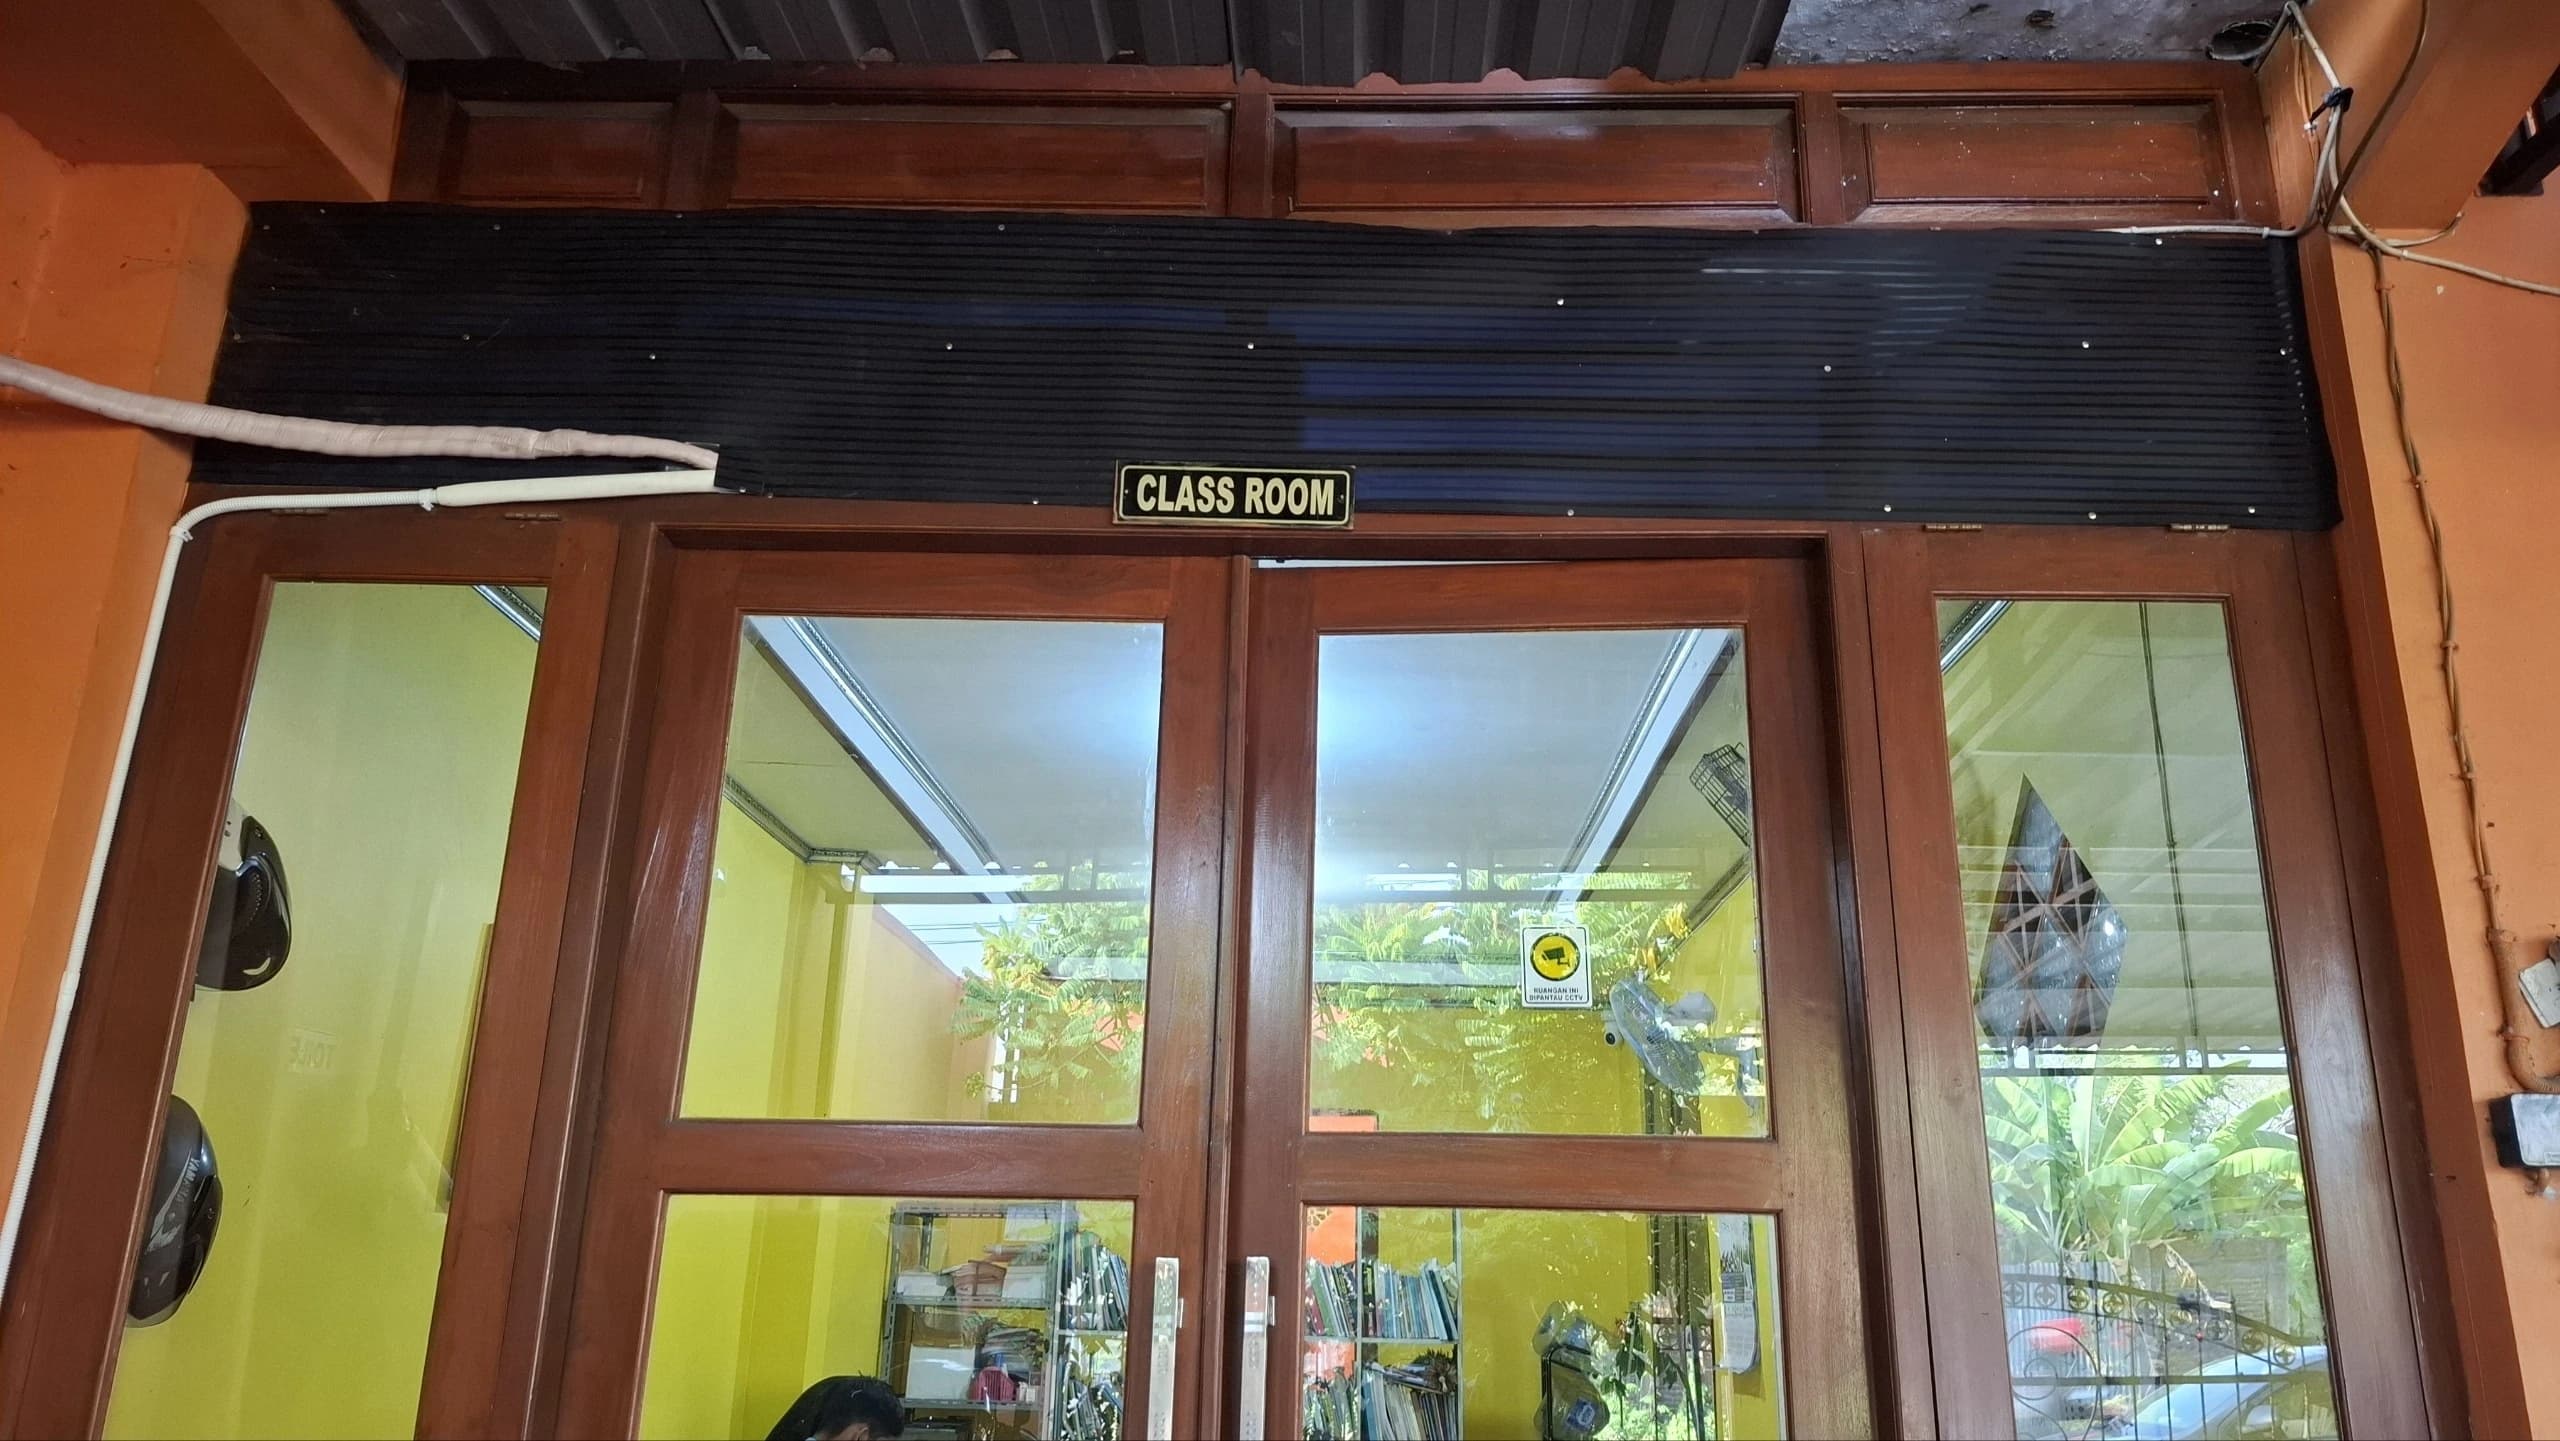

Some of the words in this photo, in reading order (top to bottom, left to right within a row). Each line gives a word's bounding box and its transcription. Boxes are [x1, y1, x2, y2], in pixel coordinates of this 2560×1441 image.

[1137, 473, 1235, 514] CLASS
[1244, 476, 1335, 516] ROOM
[1533, 986, 1567, 994] RUANGAN
[1569, 986, 1579, 994] INI
